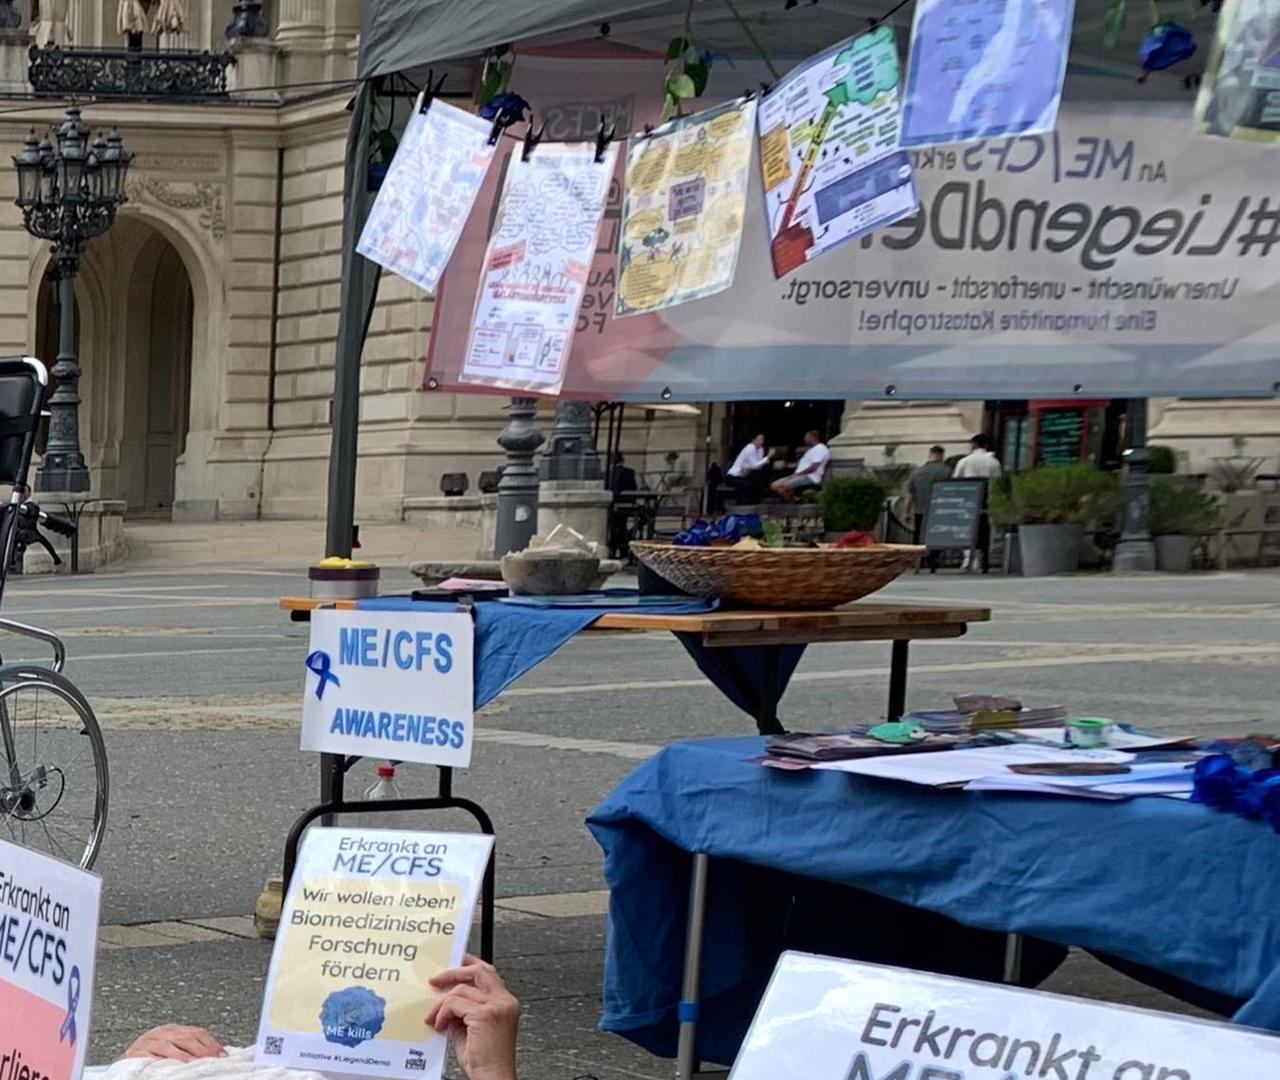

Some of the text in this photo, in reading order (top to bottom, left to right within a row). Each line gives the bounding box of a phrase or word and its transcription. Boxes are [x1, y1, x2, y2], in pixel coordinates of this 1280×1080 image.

[339, 627, 453, 674] ME/CFS
[330, 708, 464, 749] AWARENESS
[338, 837, 447, 855] Erkrankt an
[333, 852, 444, 877] ME/CFS
[303, 888, 456, 909] Wir wollen leben!
[52, 903, 70, 932] an
[291, 910, 455, 936] Biomedizinische
[308, 935, 418, 961] Forschung
[321, 960, 401, 982] fördern
[327, 1025, 372, 1039] ME kills
[300, 1051, 391, 1068] Initiative #LiegendDemo
